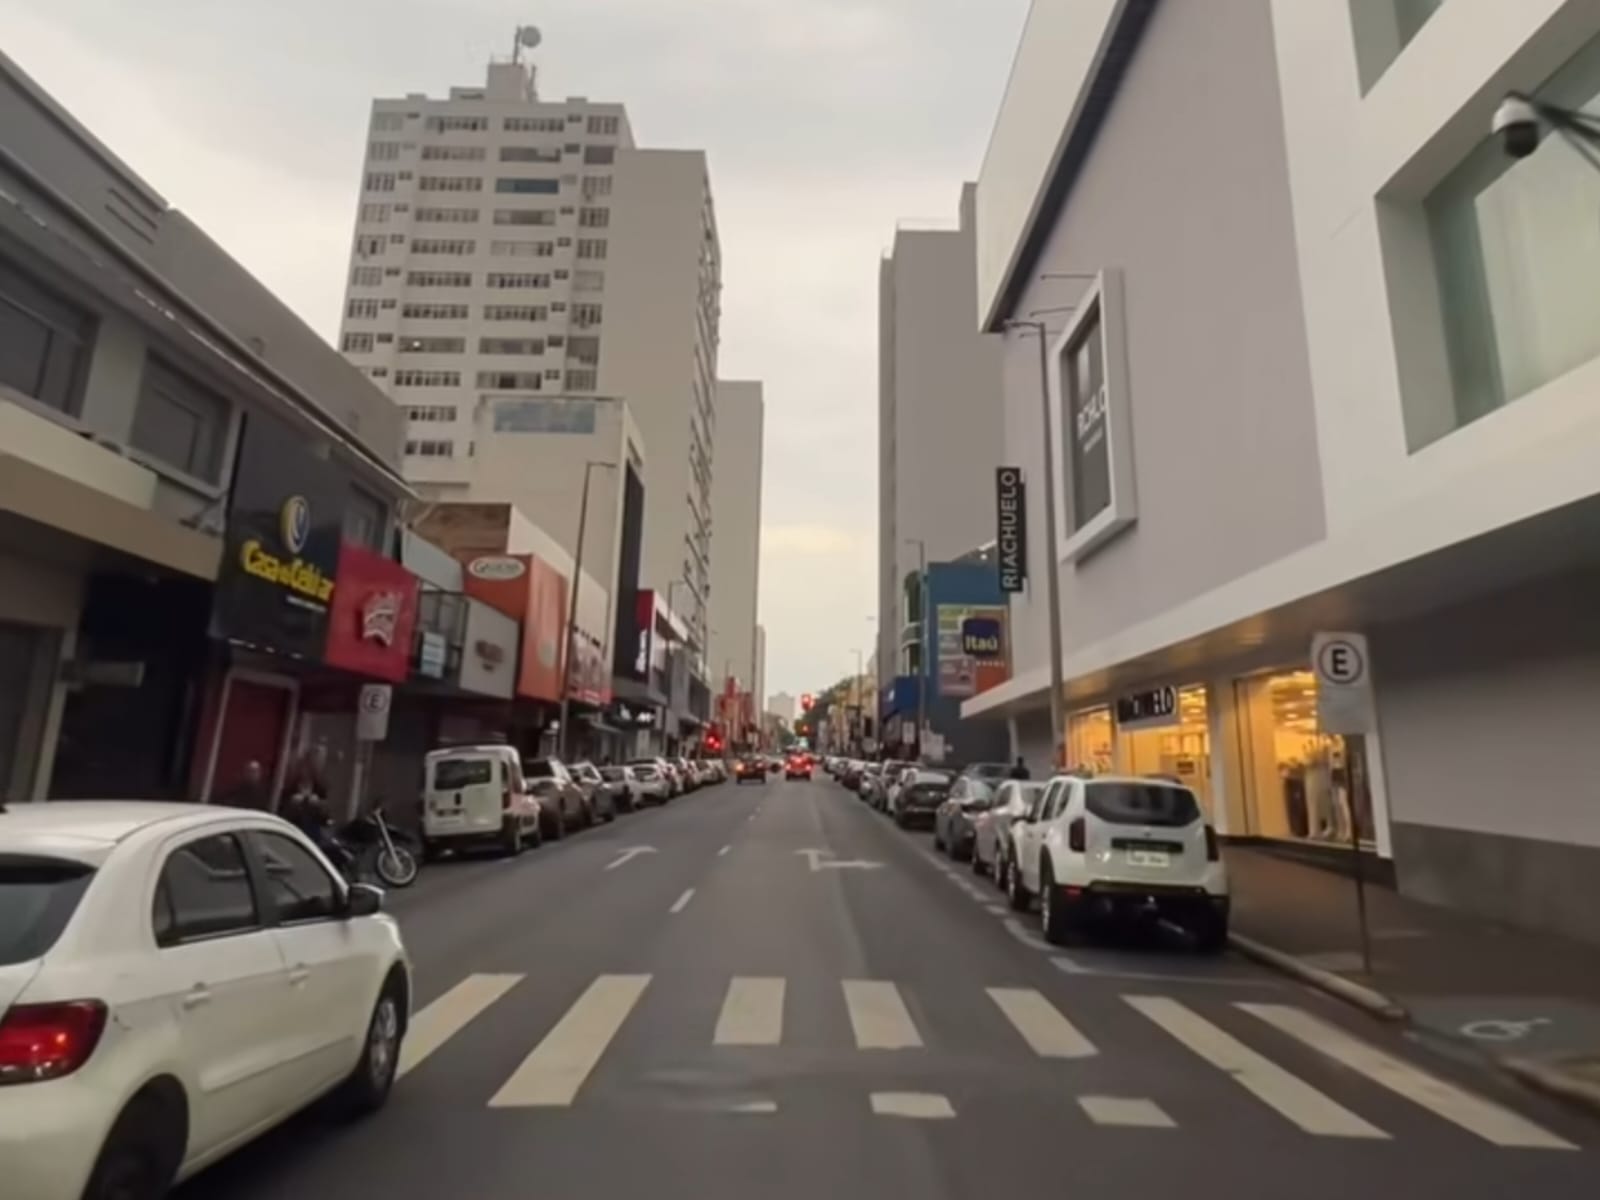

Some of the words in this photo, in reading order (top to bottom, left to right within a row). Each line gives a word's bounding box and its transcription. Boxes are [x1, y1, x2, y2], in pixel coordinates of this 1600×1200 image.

[1001, 471, 1018, 589] RIACHUELO
[964, 634, 998, 651] Itaú
[1332, 649, 1349, 675] E
[371, 694, 380, 709] E
